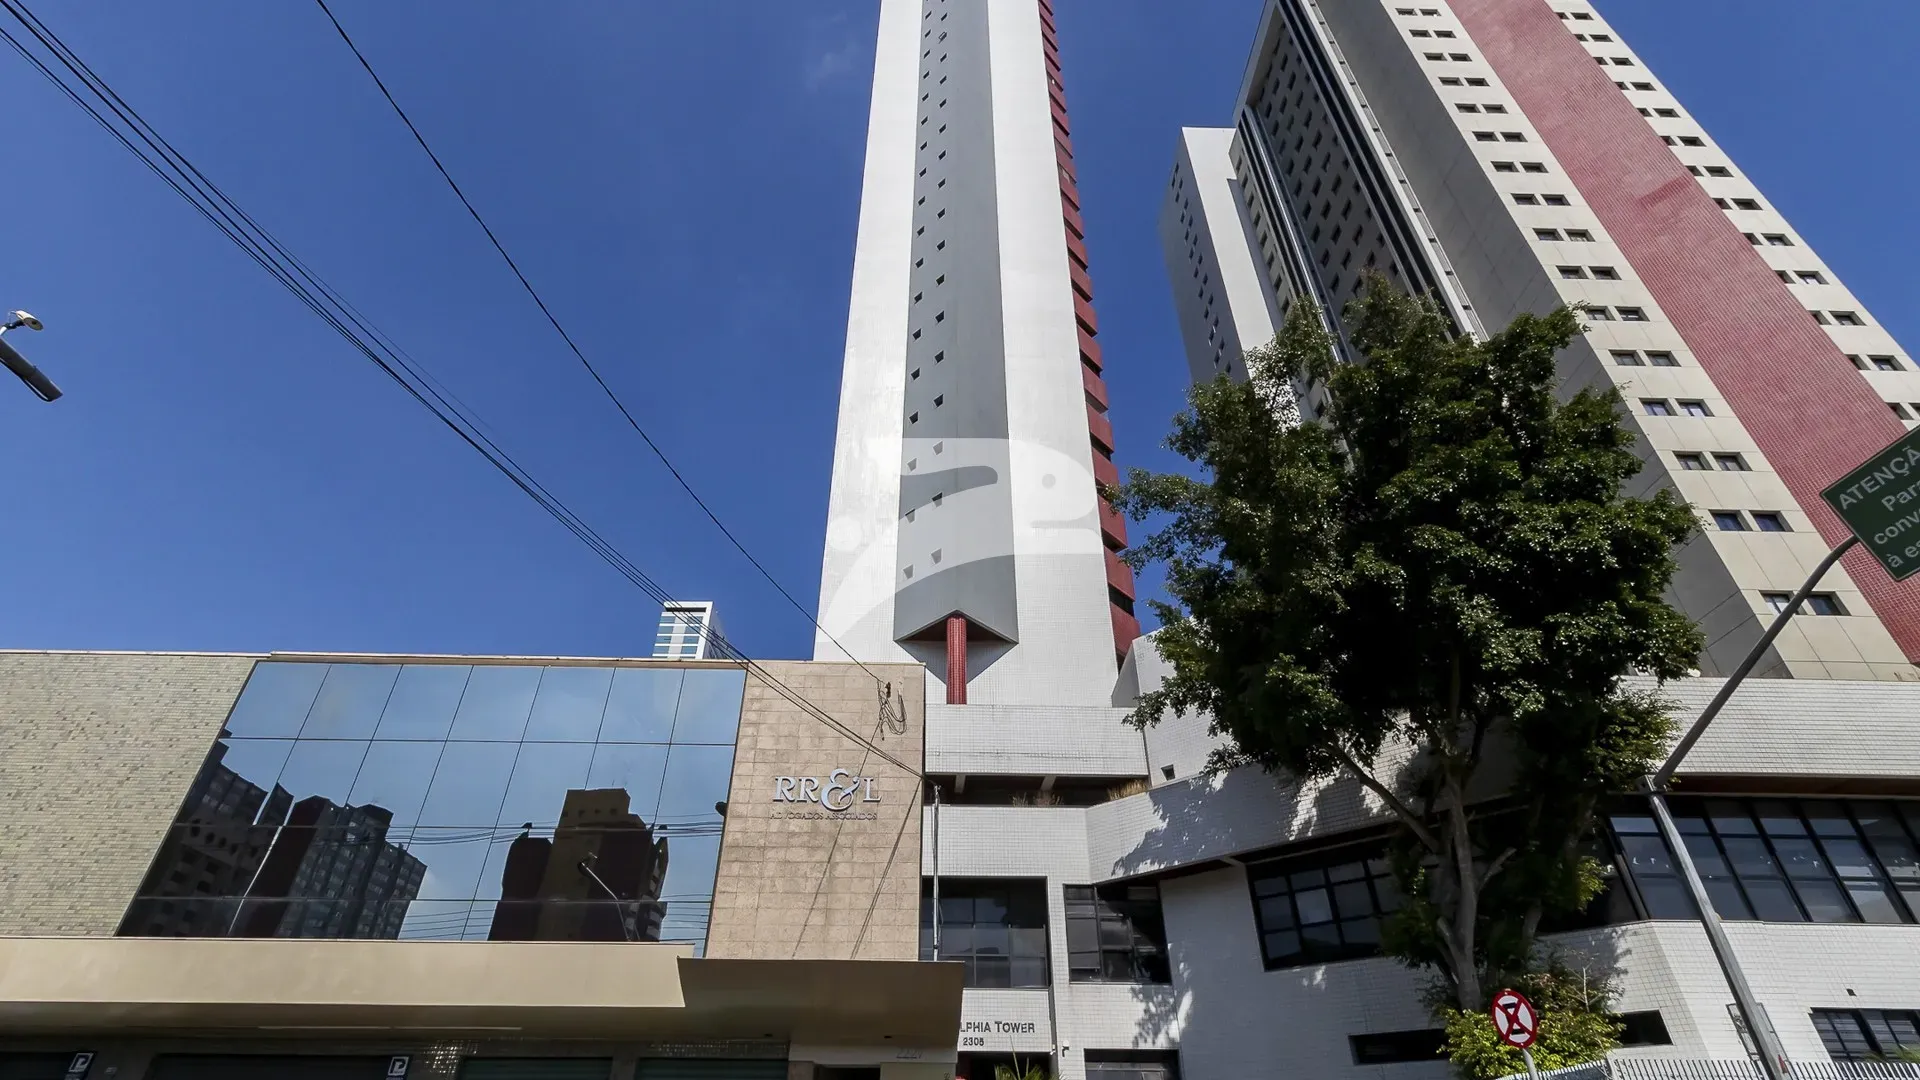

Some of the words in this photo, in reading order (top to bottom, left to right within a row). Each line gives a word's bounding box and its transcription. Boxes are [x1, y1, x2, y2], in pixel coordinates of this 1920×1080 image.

[1881, 479, 1920, 512] Par
[1874, 508, 1920, 544] conv
[995, 1021, 1035, 1033] TOWER
[963, 1037, 984, 1046] 2305
